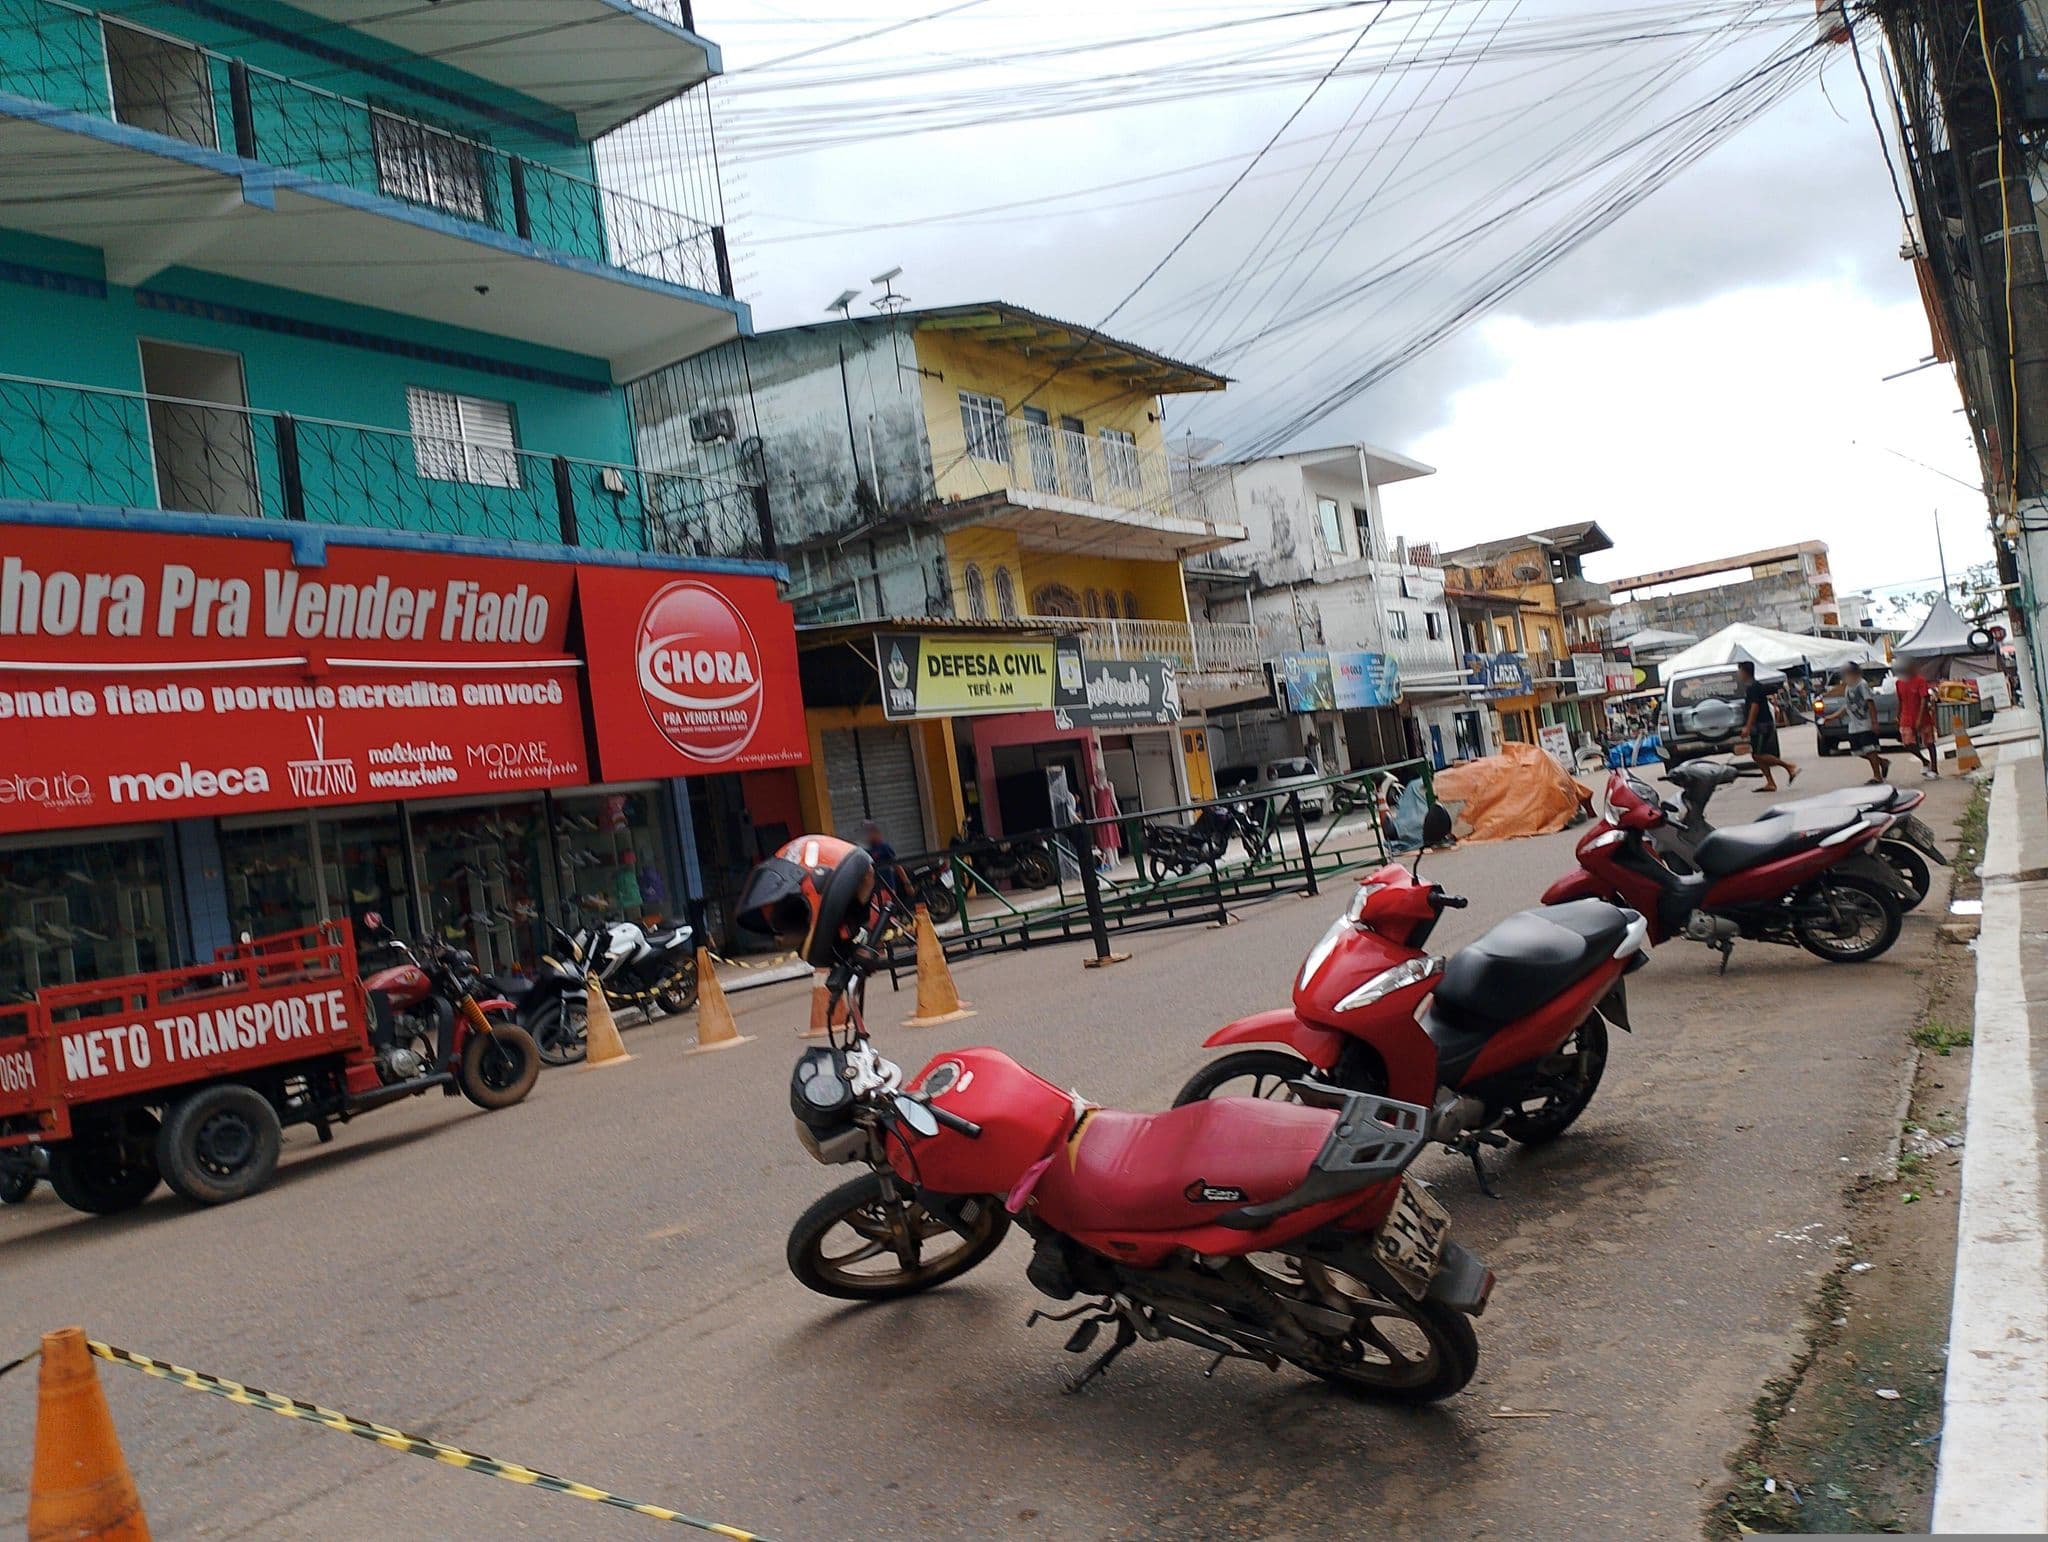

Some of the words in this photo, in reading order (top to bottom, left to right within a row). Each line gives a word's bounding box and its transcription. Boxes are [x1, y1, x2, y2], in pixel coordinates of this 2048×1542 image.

[157, 564, 251, 638] Pra
[264, 568, 435, 641] Vender
[440, 580, 549, 644] Fiado
[653, 649, 755, 685] CHORA
[926, 653, 1000, 678] DEFESA
[1003, 653, 1046, 676] CIVIL
[104, 684, 204, 716] fiado
[212, 684, 337, 714] porque
[338, 680, 457, 709] acredita
[462, 684, 500, 706] em
[500, 678, 563, 706] você
[966, 680, 992, 697] TEFÉ
[1000, 683, 1014, 696] AM
[663, 711, 682, 726] PRA
[683, 710, 720, 725] VENDER
[721, 709, 748, 724] FIADO
[466, 741, 549, 768] MODARE
[108, 762, 270, 802] moleca
[287, 765, 357, 798] VIZZANO
[61, 1023, 151, 1082] NETO
[155, 989, 349, 1063] TRANSPORTE
